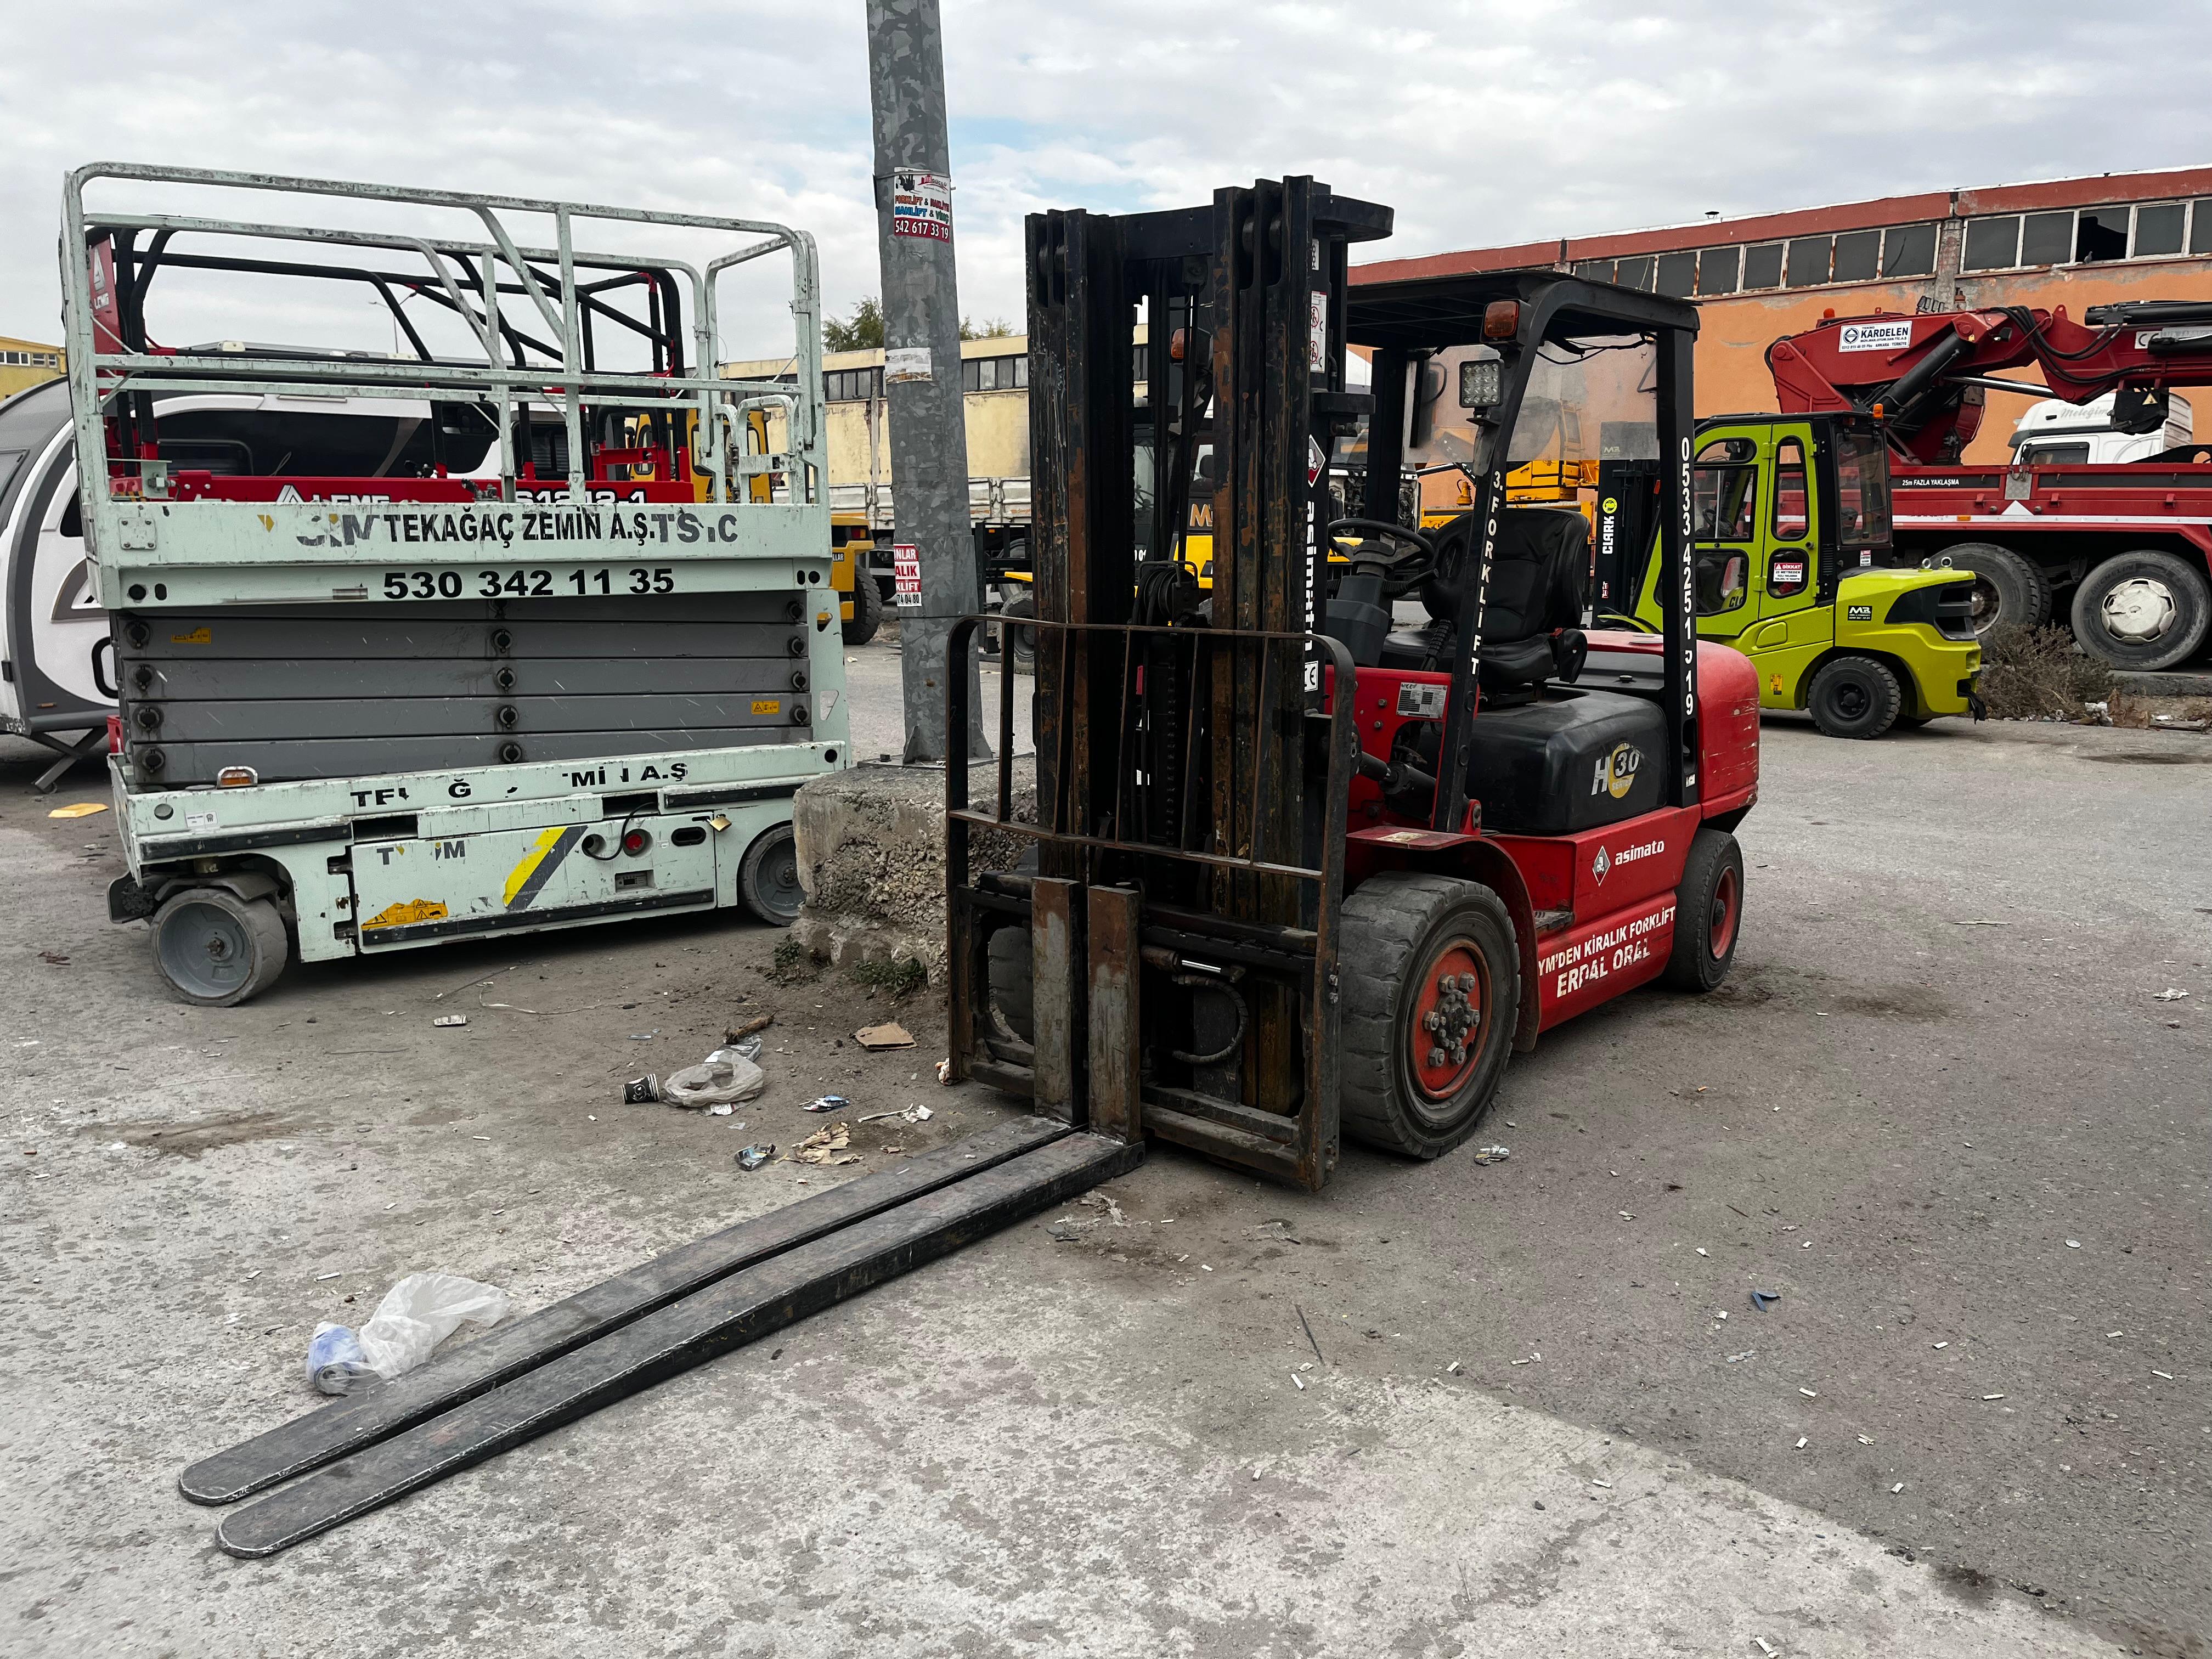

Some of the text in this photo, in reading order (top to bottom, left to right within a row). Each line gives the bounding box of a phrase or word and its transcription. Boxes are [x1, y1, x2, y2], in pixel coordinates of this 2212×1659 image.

[895, 195, 923, 206] FORKLİFT
[895, 206, 928, 217] MANLİFT
[895, 220, 949, 239] 542 617 33 19
[1860, 327, 1909, 338] KARDELEN
[1931, 478, 1960, 487] YAKLAŞMA
[383, 506, 514, 548] TEKAĞAÇ
[522, 506, 601, 541] ZEMİN
[1602, 516, 1614, 554] CLARK
[384, 568, 674, 600] 530 342 11 35
[1591, 756, 1611, 795] H
[1615, 750, 1640, 777] 30
[1615, 840, 1664, 866] asimato
[1584, 925, 1628, 958] KİRALIK
[1629, 906, 1676, 939] FORKLİFT
